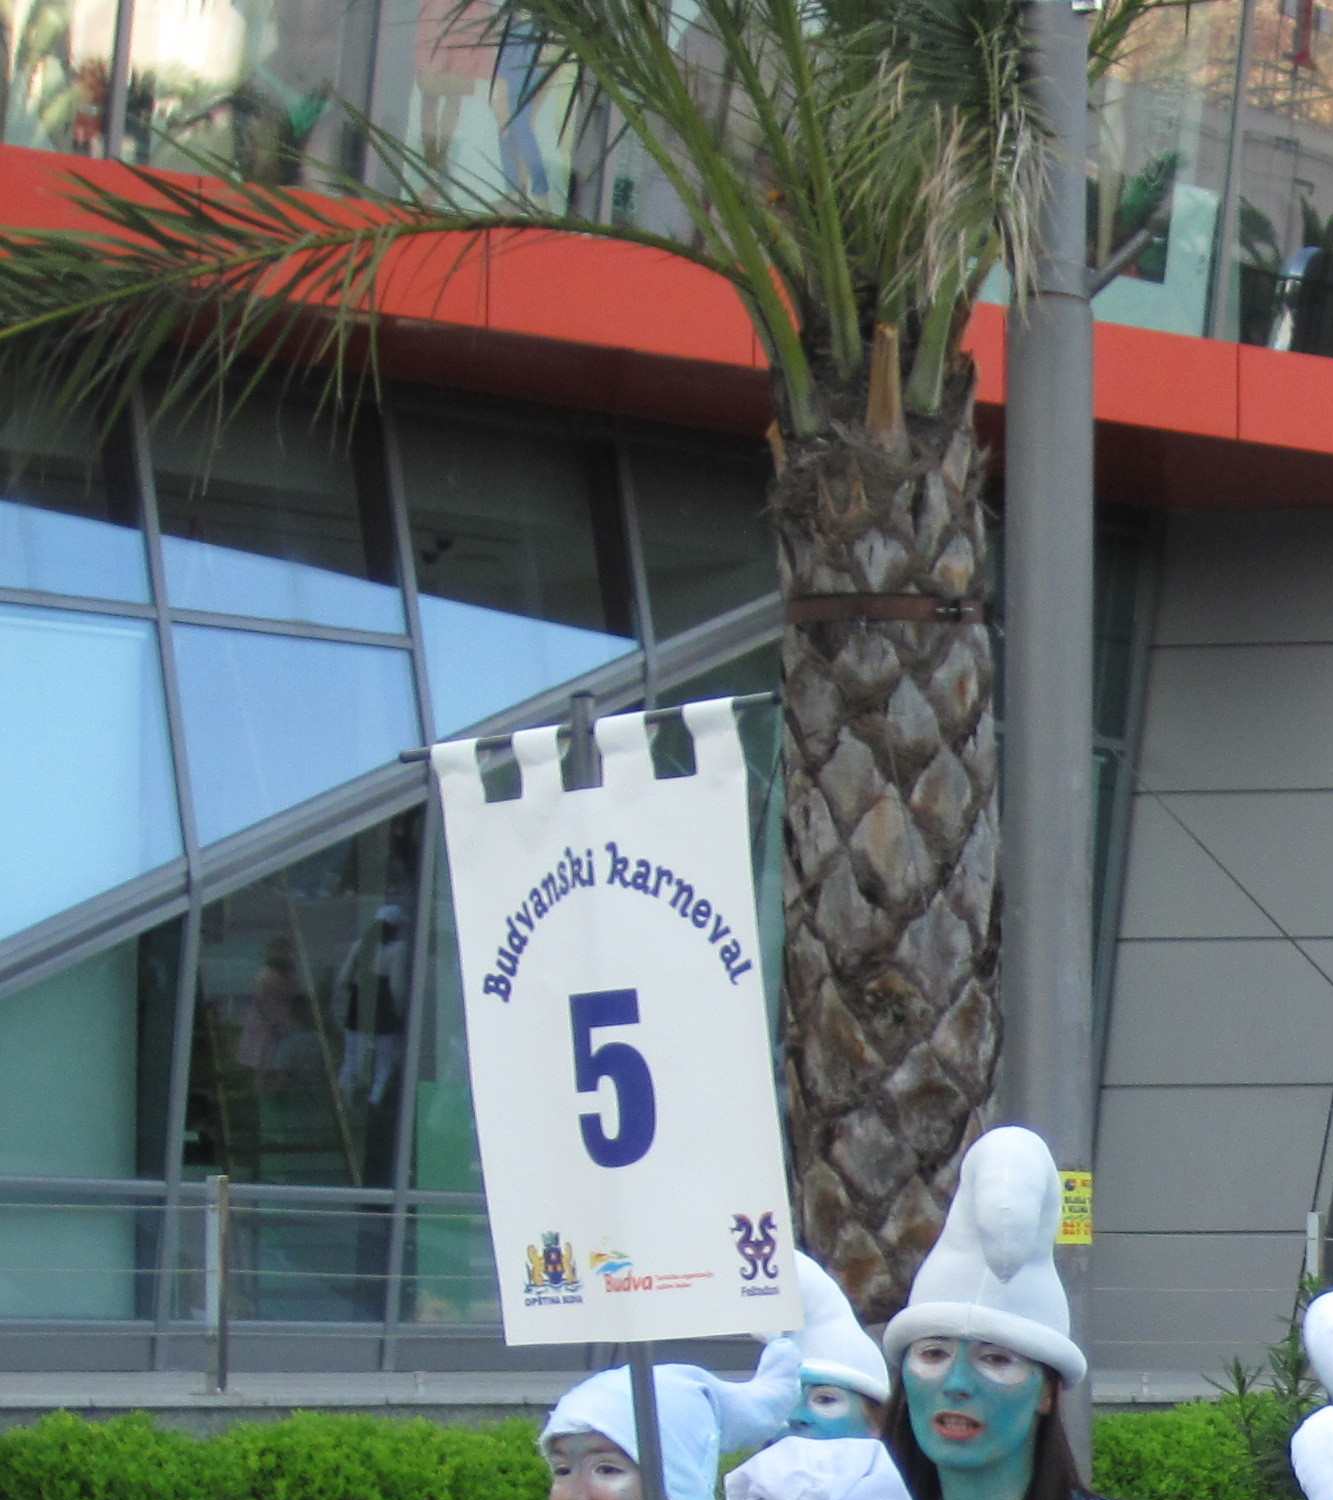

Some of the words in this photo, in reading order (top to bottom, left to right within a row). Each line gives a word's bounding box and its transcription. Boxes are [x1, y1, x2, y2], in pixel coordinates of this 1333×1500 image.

[483, 846, 595, 1003] Budvanski
[605, 841, 752, 986] karneval
[569, 988, 657, 1168] 5
[604, 1271, 652, 1293] Budva
